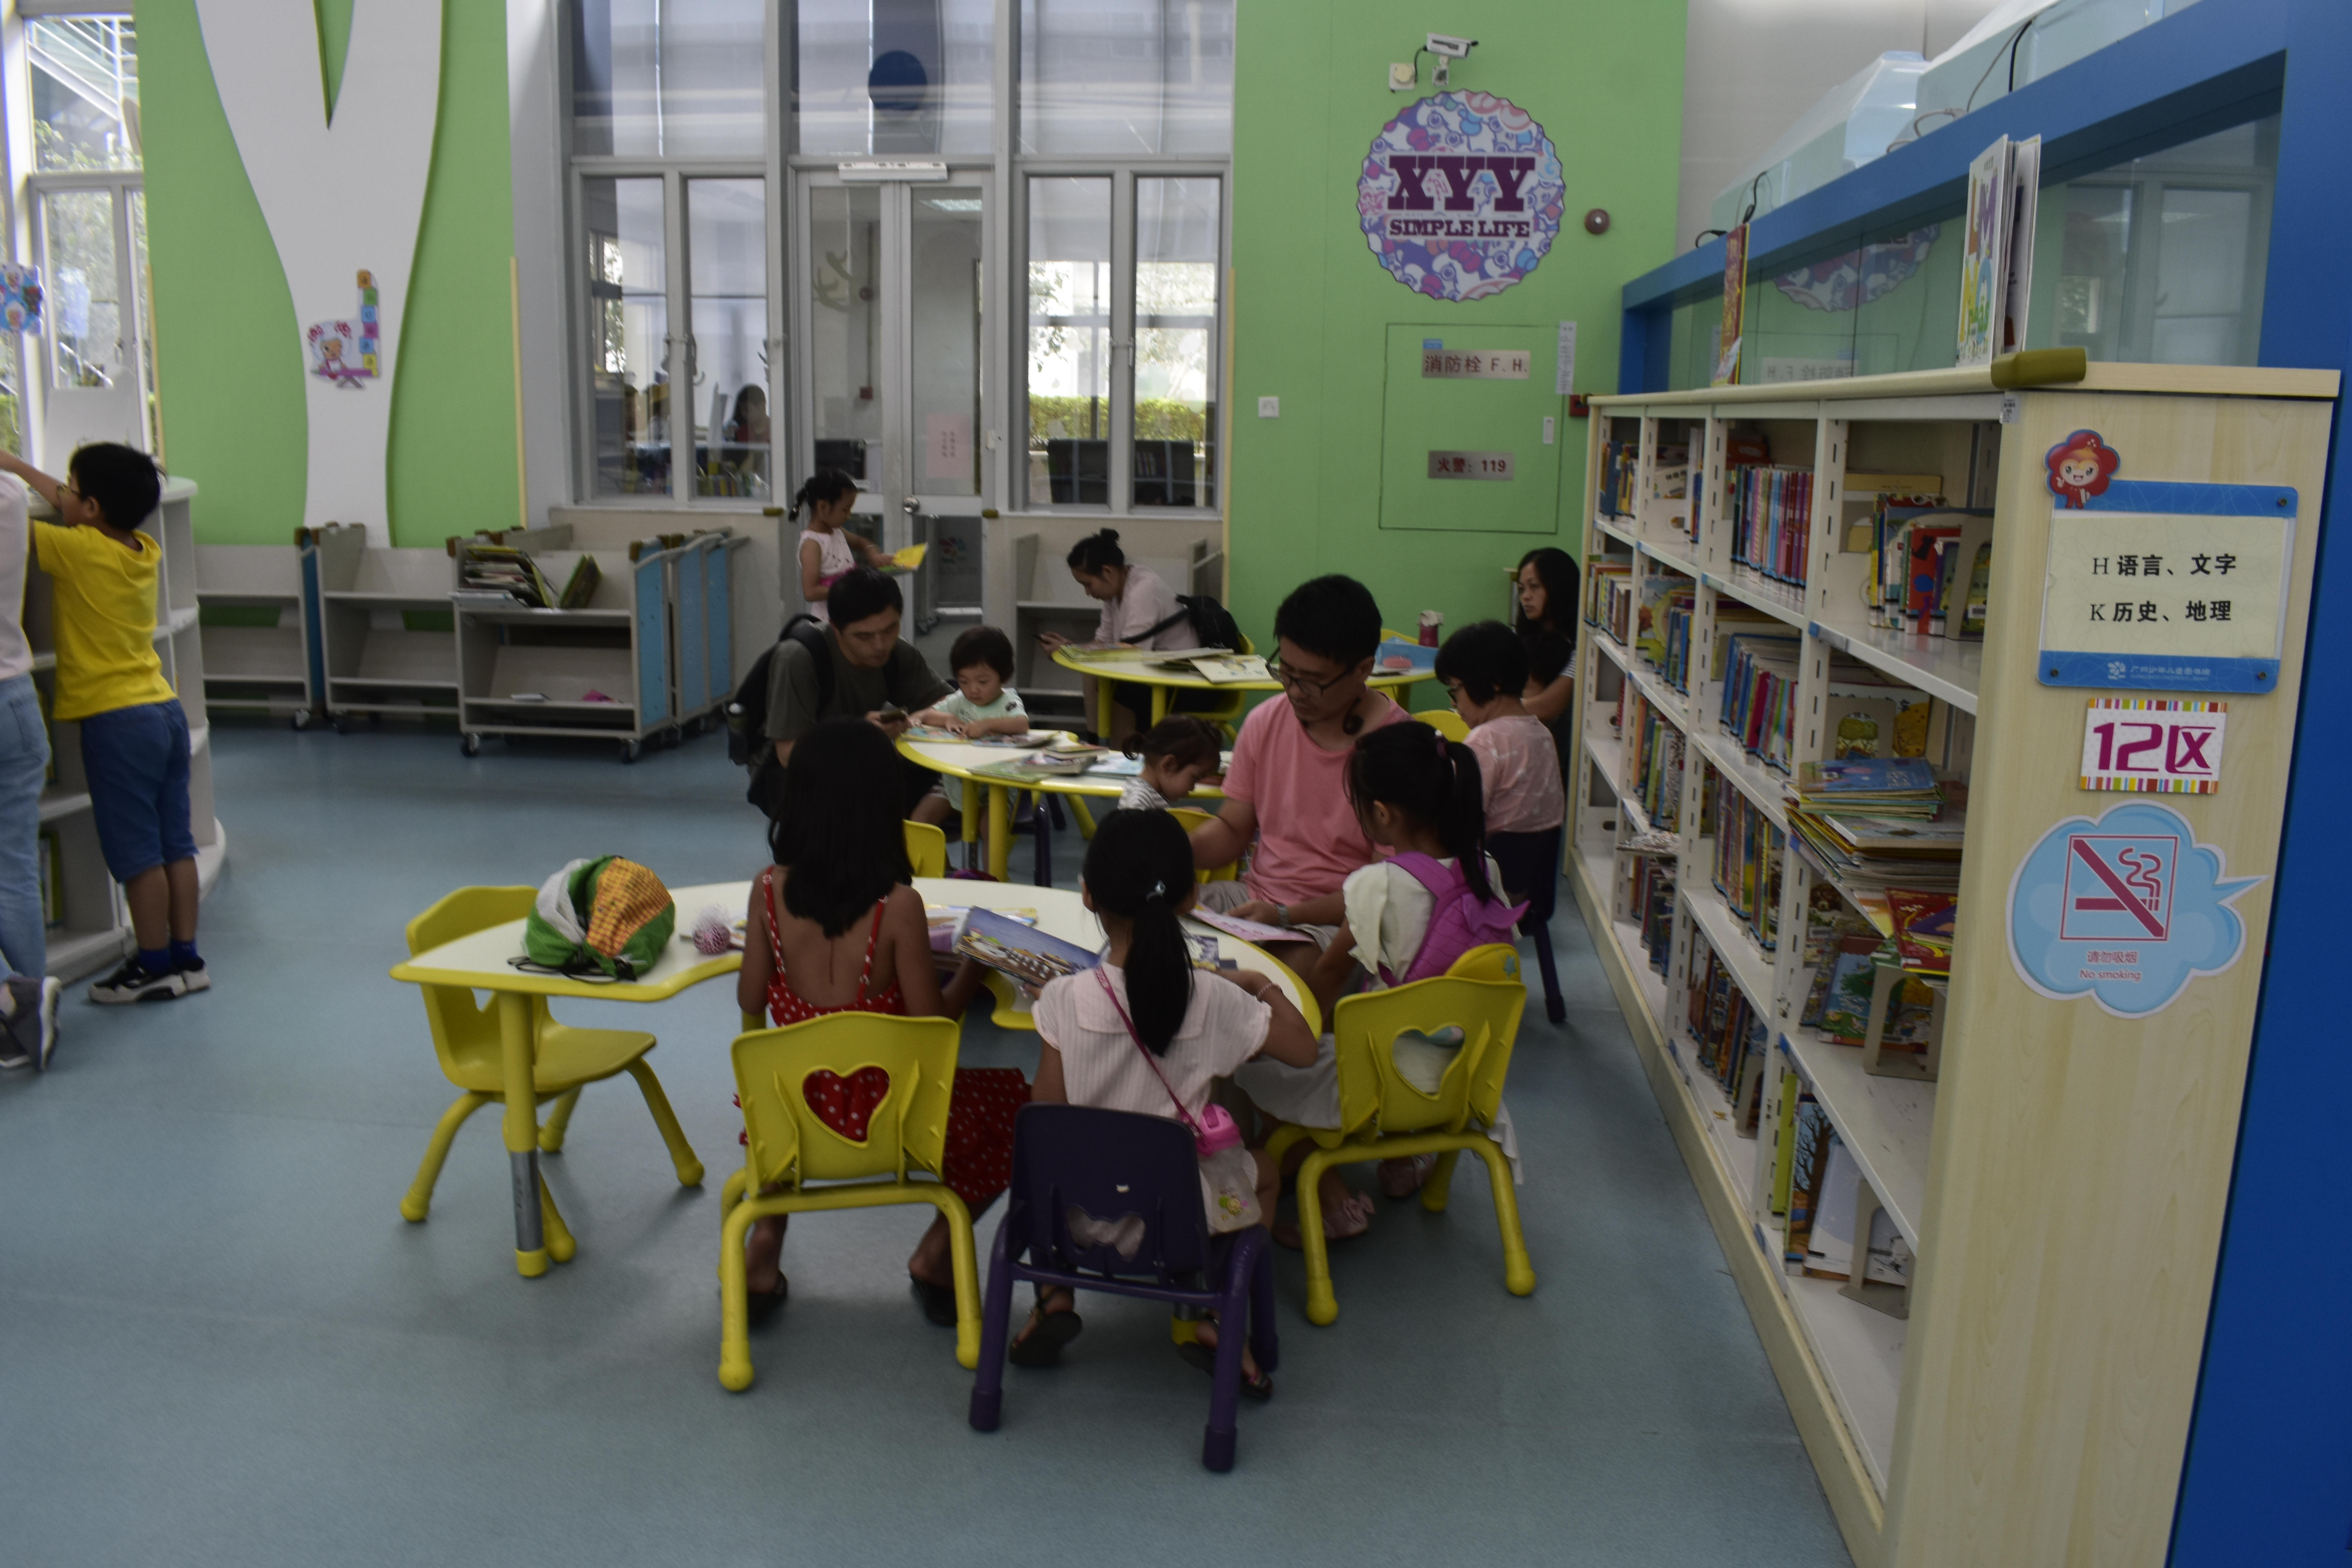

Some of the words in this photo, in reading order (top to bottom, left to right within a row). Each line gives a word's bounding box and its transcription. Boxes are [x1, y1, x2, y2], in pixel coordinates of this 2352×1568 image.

[1387, 156, 1535, 212] XYY
[1390, 219, 1474, 236] SIMPLE
[1477, 220, 1530, 237] LIFE
[1425, 354, 1481, 373] 消防栓
[2087, 950, 2138, 964] 请勿吸烟
[2080, 969, 2095, 979] No
[2098, 969, 2141, 982] smoking
